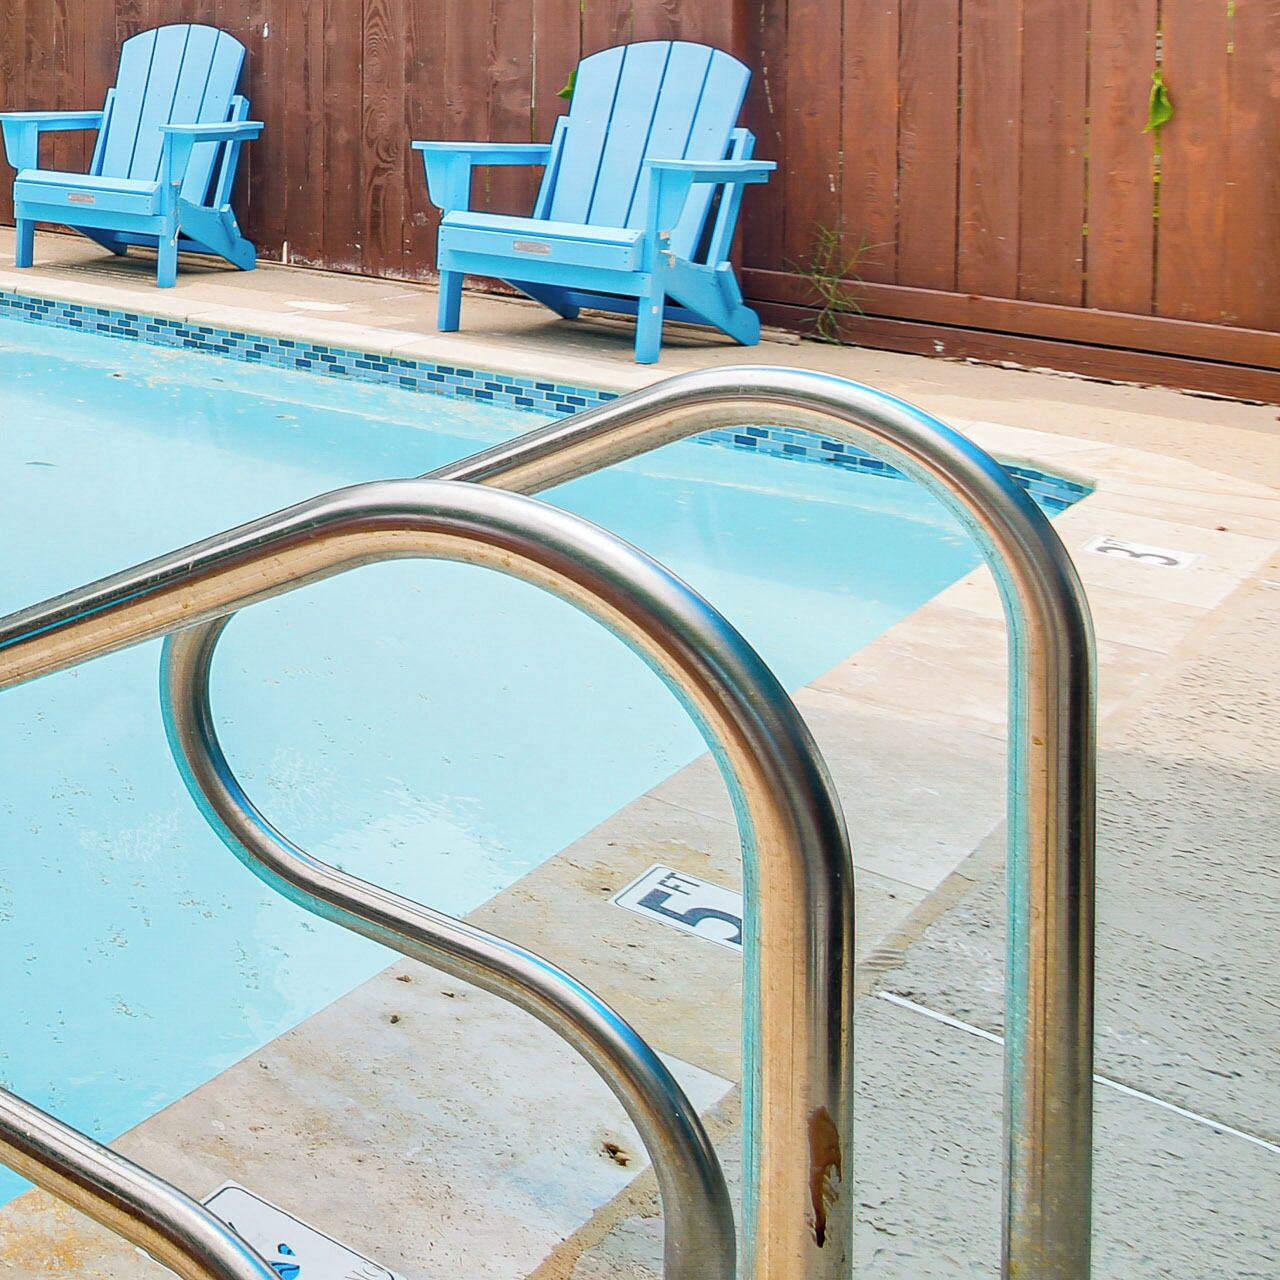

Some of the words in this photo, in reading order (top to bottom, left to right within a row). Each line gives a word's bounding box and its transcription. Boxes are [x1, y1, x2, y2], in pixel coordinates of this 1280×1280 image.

[1096, 546, 1179, 566] 3
[657, 871, 701, 896] FT
[636, 888, 742, 946] 5
